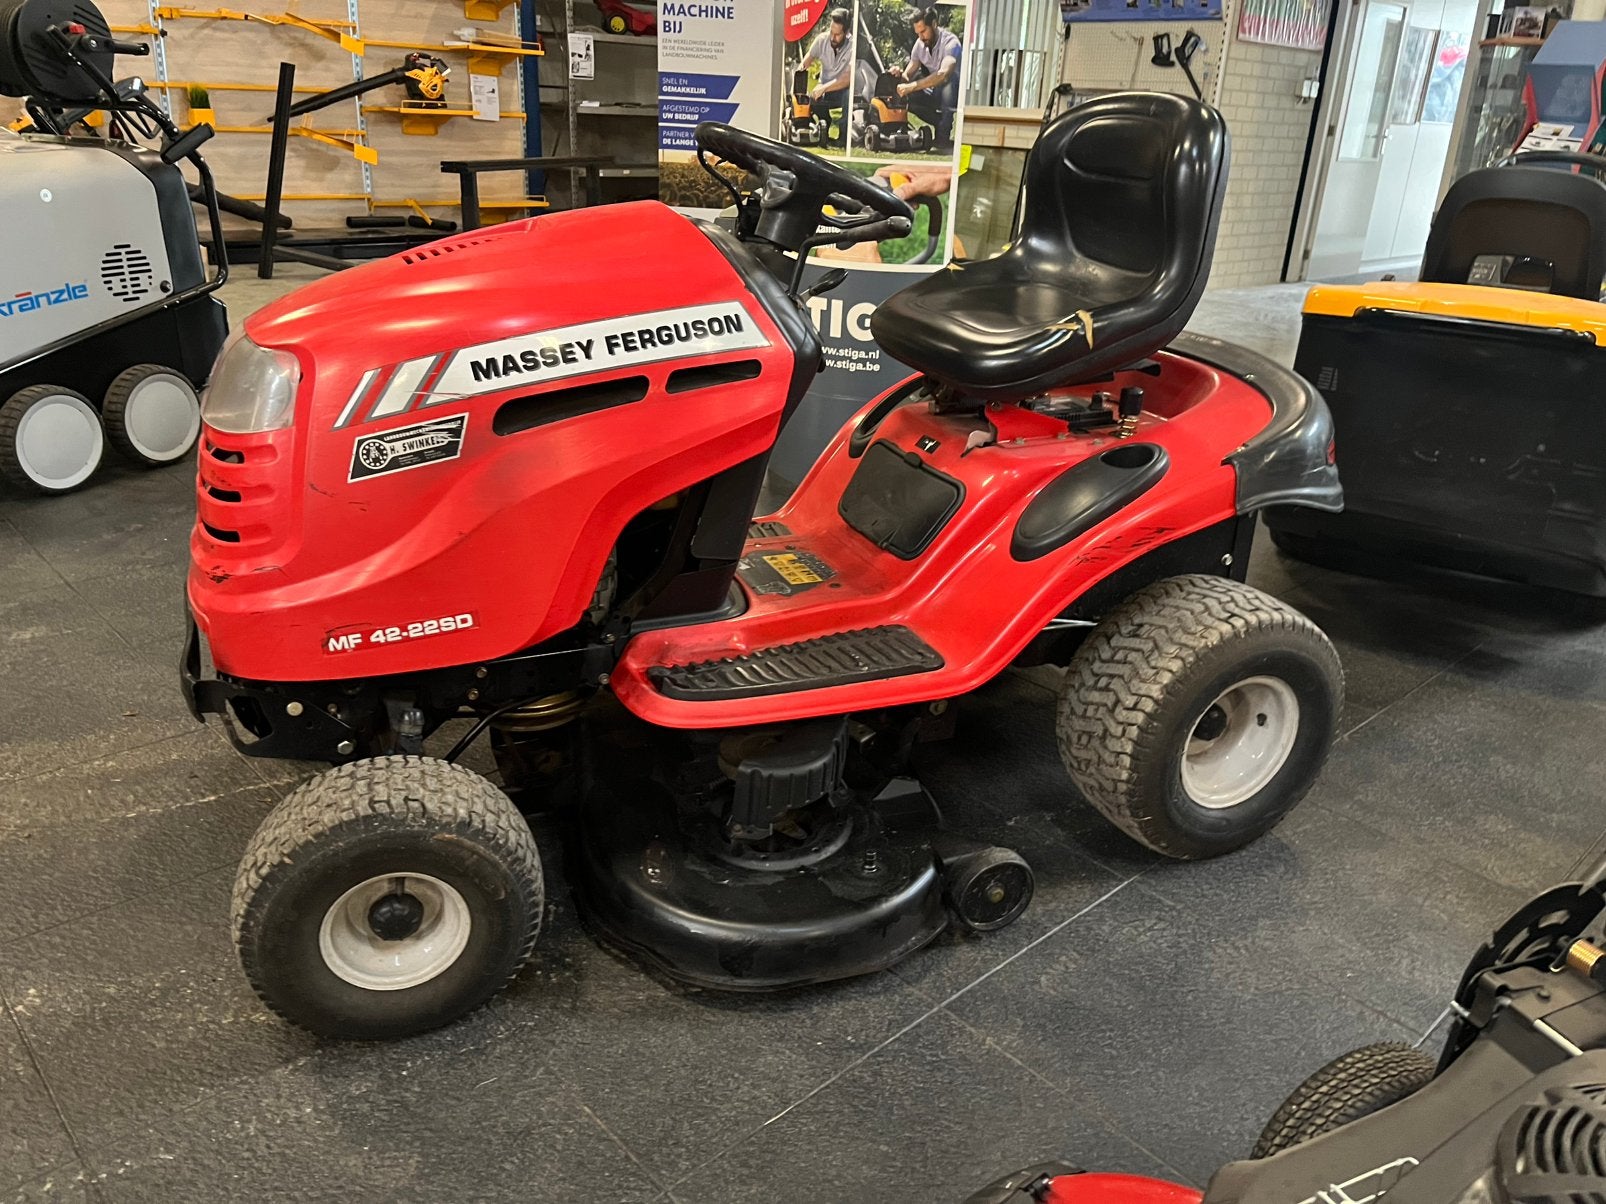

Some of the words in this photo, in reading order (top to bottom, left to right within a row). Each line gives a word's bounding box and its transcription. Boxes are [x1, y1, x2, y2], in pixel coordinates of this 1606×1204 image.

[662, 2, 734, 19] MACHINE
[662, 20, 683, 33] BIJ
[662, 77, 678, 85] SNEL
[662, 85, 706, 94] GEMAKKELIJK
[662, 104, 700, 113] AFGESTEMD
[674, 113, 699, 121] BEDRIJF
[662, 130, 690, 138] PARTNER
[672, 138, 694, 146] LANGE
[805, 296, 878, 341] TIG
[469, 338, 595, 382] MASSEY
[604, 313, 744, 355] FERGUSON
[825, 359, 881, 372] w.stiga.be
[389, 445, 399, 455] H.
[328, 633, 363, 652] MF
[369, 613, 474, 644] 42-22SD
